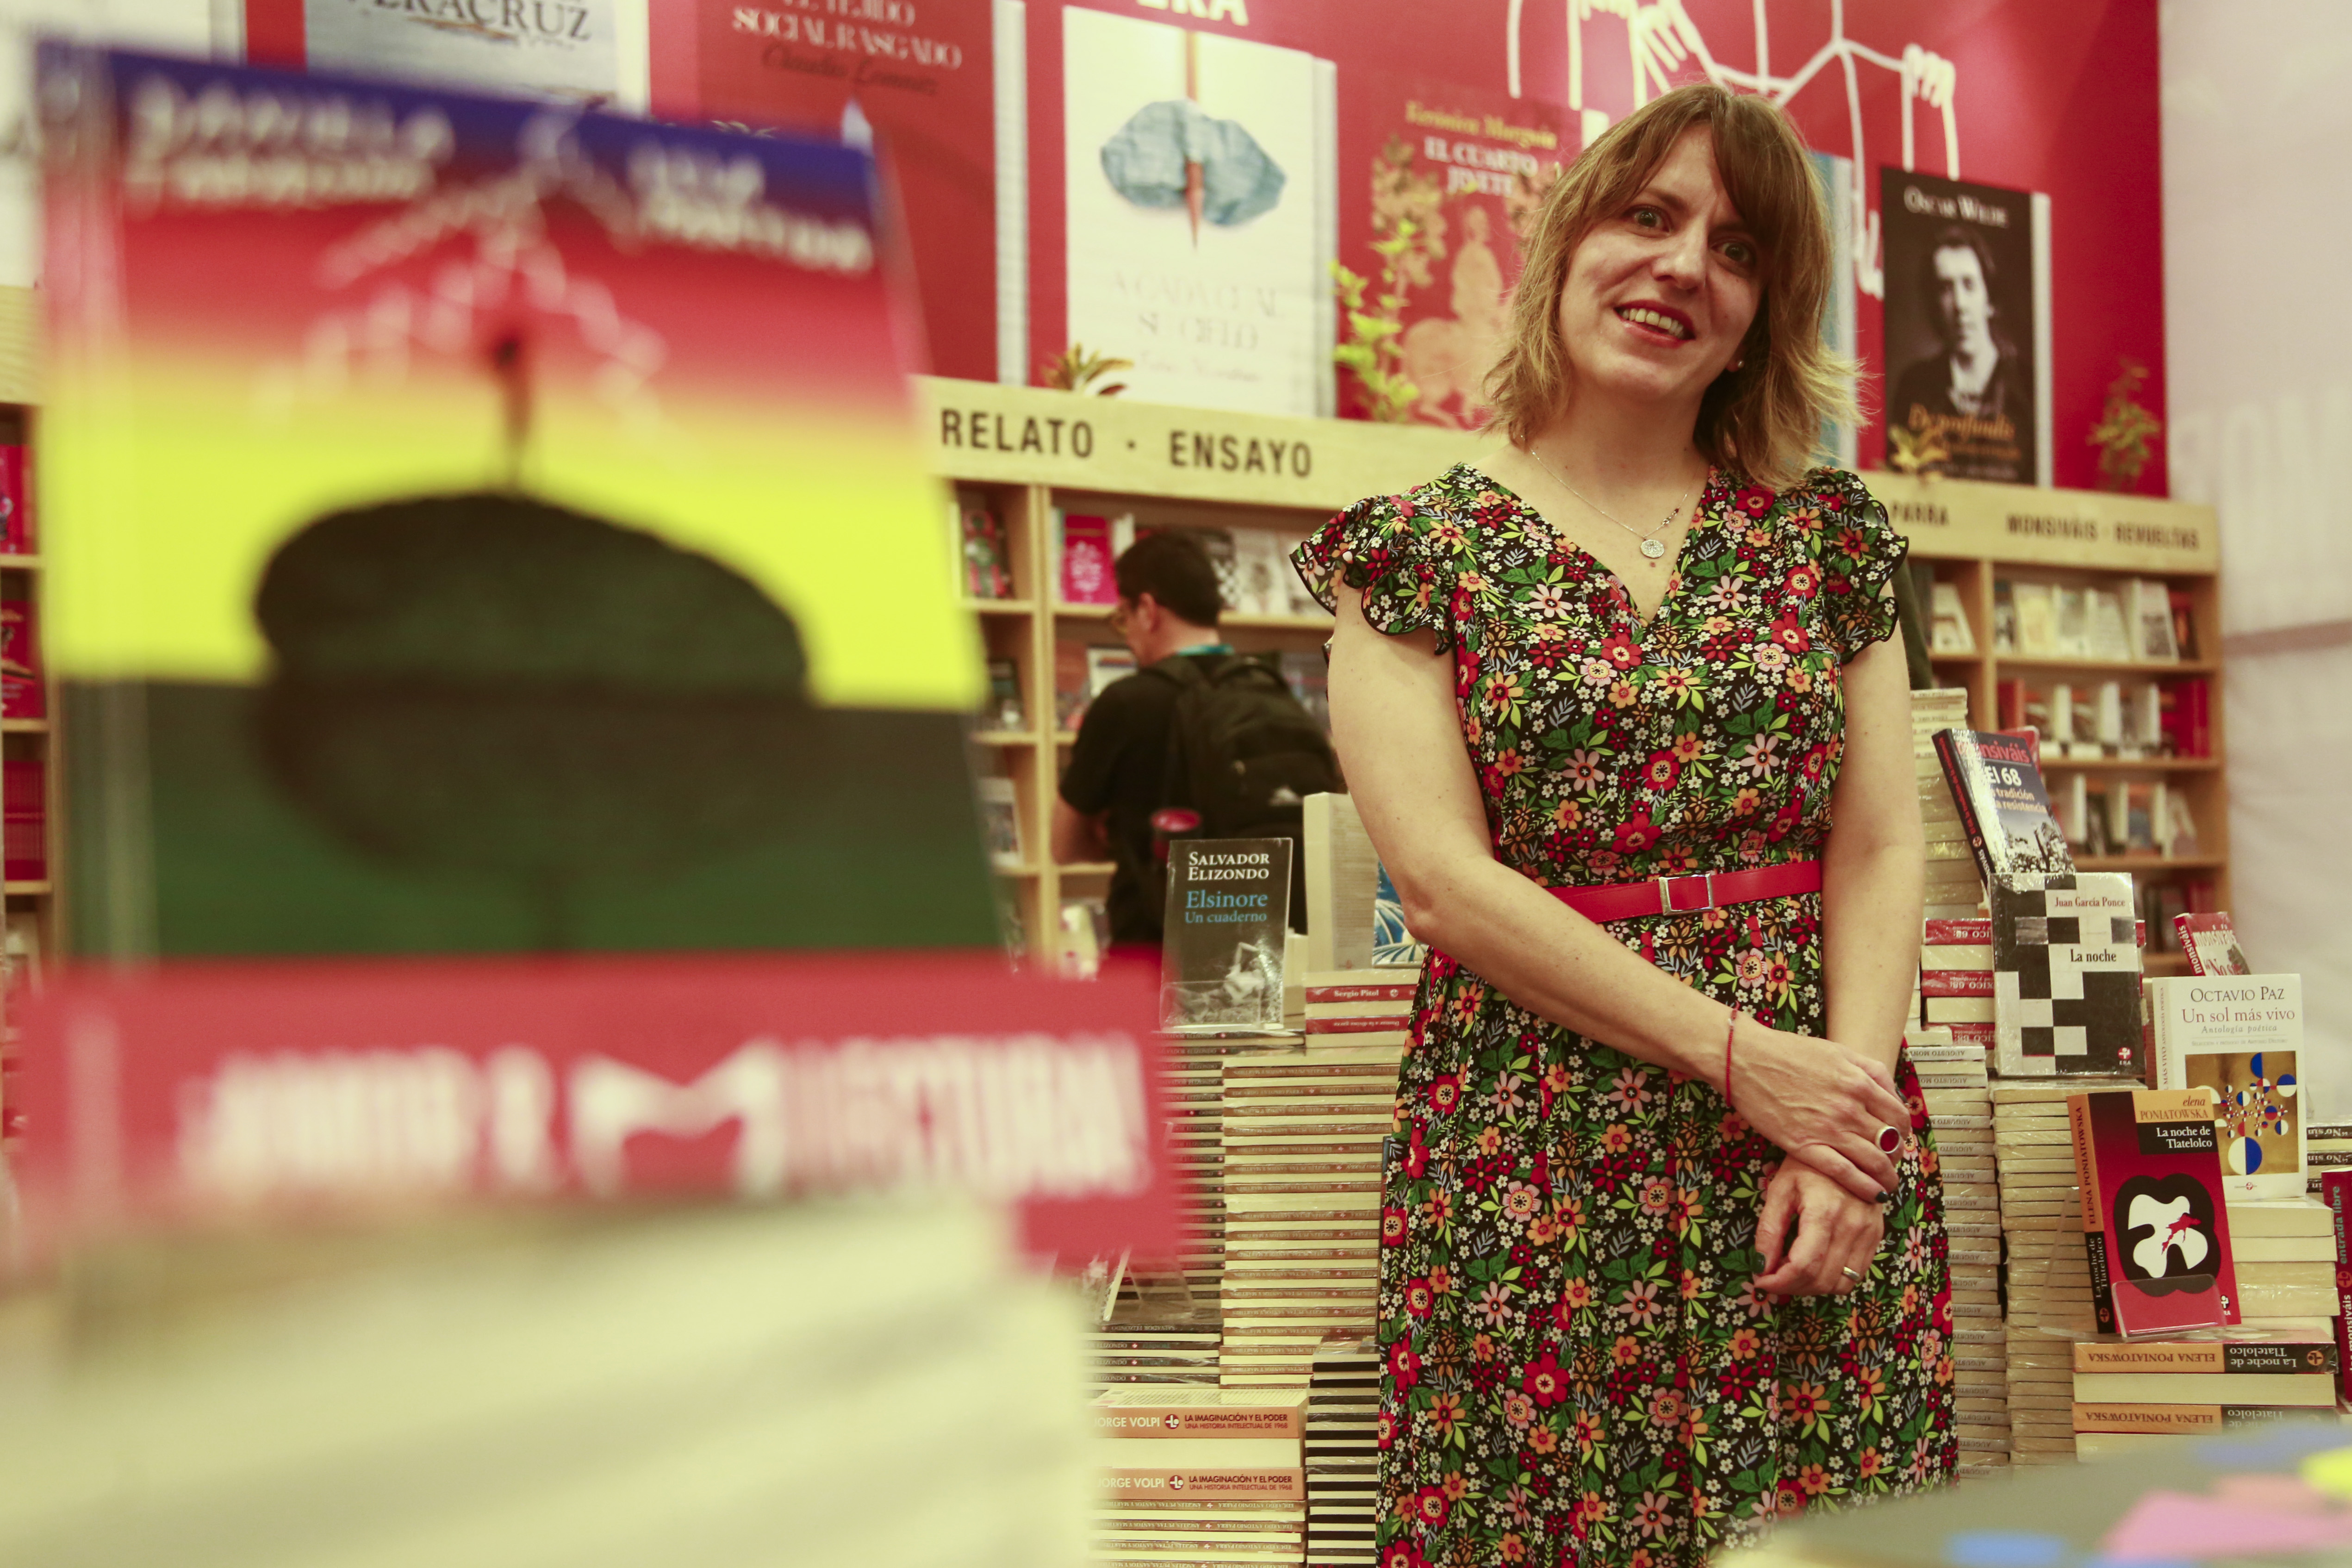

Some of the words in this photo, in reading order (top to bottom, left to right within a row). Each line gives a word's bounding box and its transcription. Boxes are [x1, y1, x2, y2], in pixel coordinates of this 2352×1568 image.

[940, 408, 1093, 458] RELATO
[1170, 430, 1312, 478] ENSAYO
[2001, 767, 2022, 786] 68
[1189, 852, 1269, 866] SALVADOR
[1188, 866, 1269, 881] ELIZONDO
[1186, 890, 1268, 908] Elsinore
[2055, 897, 2072, 907] Juan
[2075, 896, 2099, 907] García
[2102, 897, 2125, 906] Ponce
[1185, 912, 1203, 923] Un
[1207, 910, 1267, 923] cuaderno
[2070, 949, 2082, 962] La
[2086, 949, 2116, 962] noche
[2178, 925, 2203, 975] monsiváis
[1334, 989, 1359, 999] Sergio
[2190, 989, 2255, 1002] OCTAVIO
[2260, 986, 2284, 1000] PAZ
[2182, 1008, 2204, 1023] Un
[2210, 1007, 2228, 1022] sol
[2235, 1008, 2262, 1021] más
[2266, 1007, 2295, 1020] vivo
[2202, 1025, 2243, 1034] Antología
[2248, 1025, 2277, 1033] poética
[2183, 1095, 2205, 1106] elena
[2140, 1109, 2209, 1120] PONIATOWSKA
[2156, 1127, 2168, 1137] La
[2170, 1126, 2197, 1137] noche
[2199, 1126, 2210, 1135] de
[2075, 1107, 2091, 1186] PONIATOWSKA
[2166, 1138, 2212, 1148] Tlatelolco
[2332, 1186, 2341, 1213] libre
[2086, 1189, 2096, 1225] ELENA
[2334, 1215, 2347, 1264] entrada
[2091, 1252, 2099, 1285] noche
[2096, 1286, 2102, 1297] La
[2088, 1353, 2174, 1362] PONIATOWSKA
[2178, 1353, 2215, 1362] ELENA
[2229, 1348, 2287, 1357] Tlatelolco
[2230, 1358, 2244, 1367] de
[2245, 1358, 2280, 1367] noche
[2283, 1358, 2296, 1368] La
[1094, 1417, 1127, 1427] JORGE
[1129, 1417, 1160, 1427] VOLPI
[1195, 1412, 1247, 1421] IMAGINACIÓN
[2086, 1412, 2172, 1423] PONIATOWSKA
[2175, 1413, 2213, 1423] ELENA
[1134, 1478, 1164, 1488] VOLPI
[1199, 1474, 1251, 1482] IMAGINACIÓN
